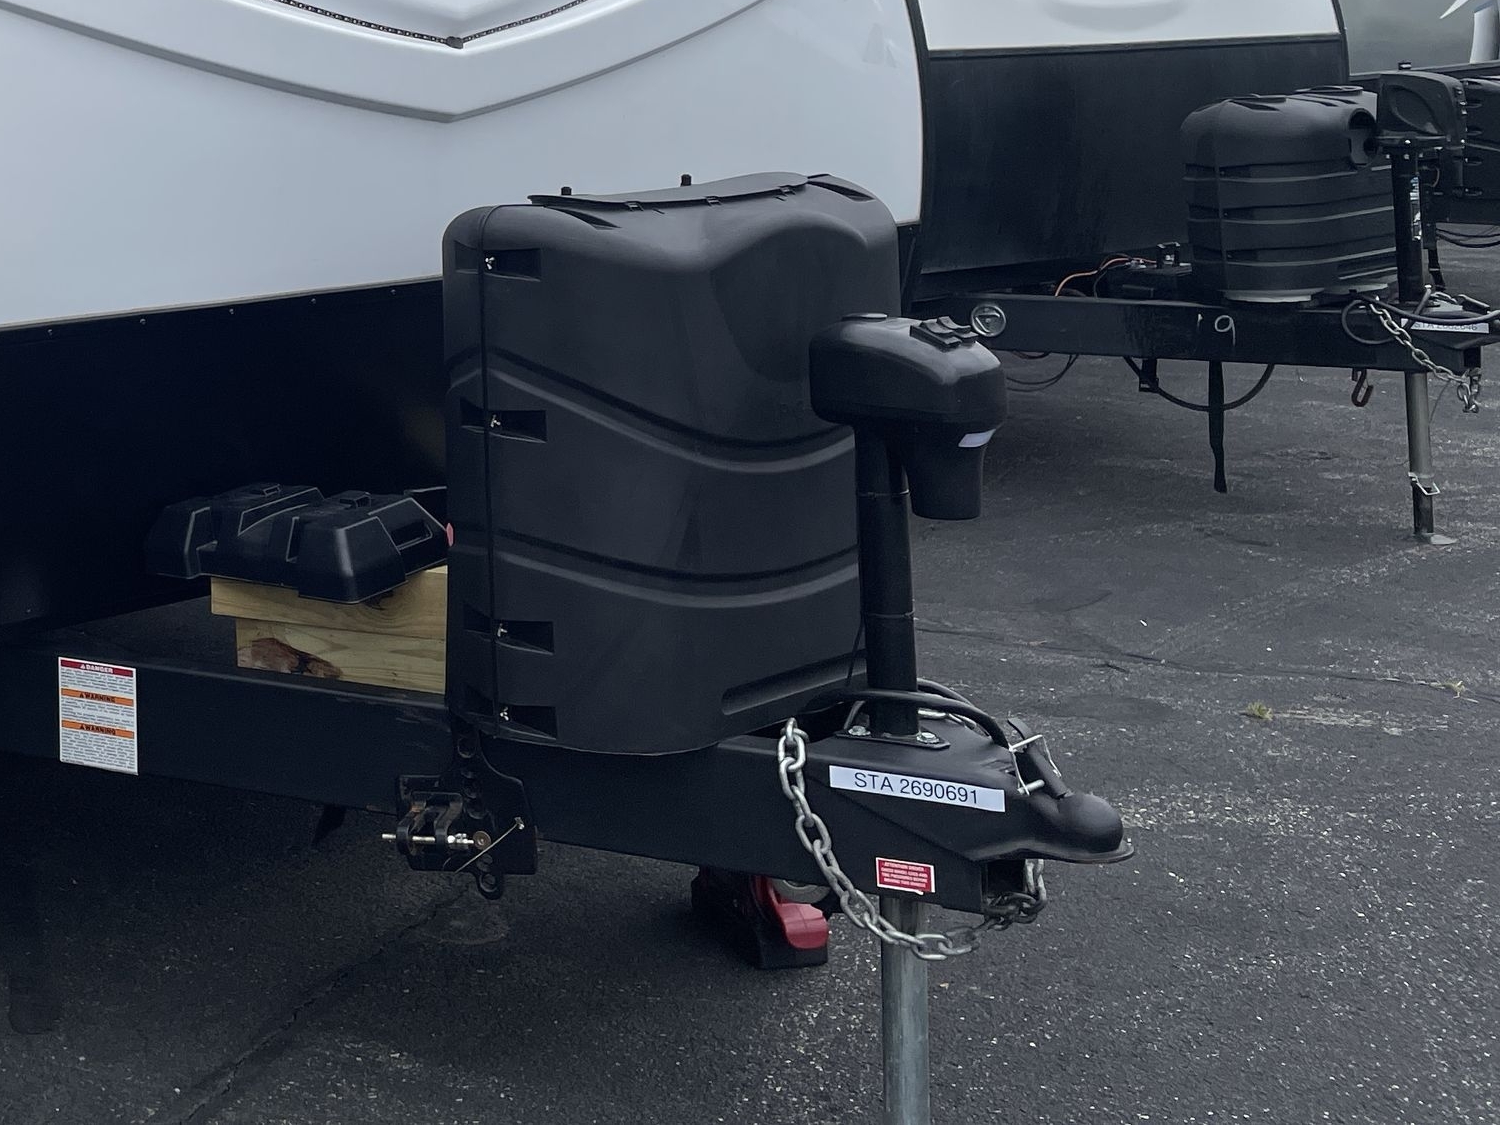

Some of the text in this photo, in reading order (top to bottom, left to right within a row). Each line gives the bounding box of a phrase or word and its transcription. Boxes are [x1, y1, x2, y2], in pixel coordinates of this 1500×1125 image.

[86, 664, 114, 674] DANGER
[85, 692, 116, 703] WARNING
[85, 724, 116, 735] WARNING
[854, 772, 977, 804] STA 2690691
